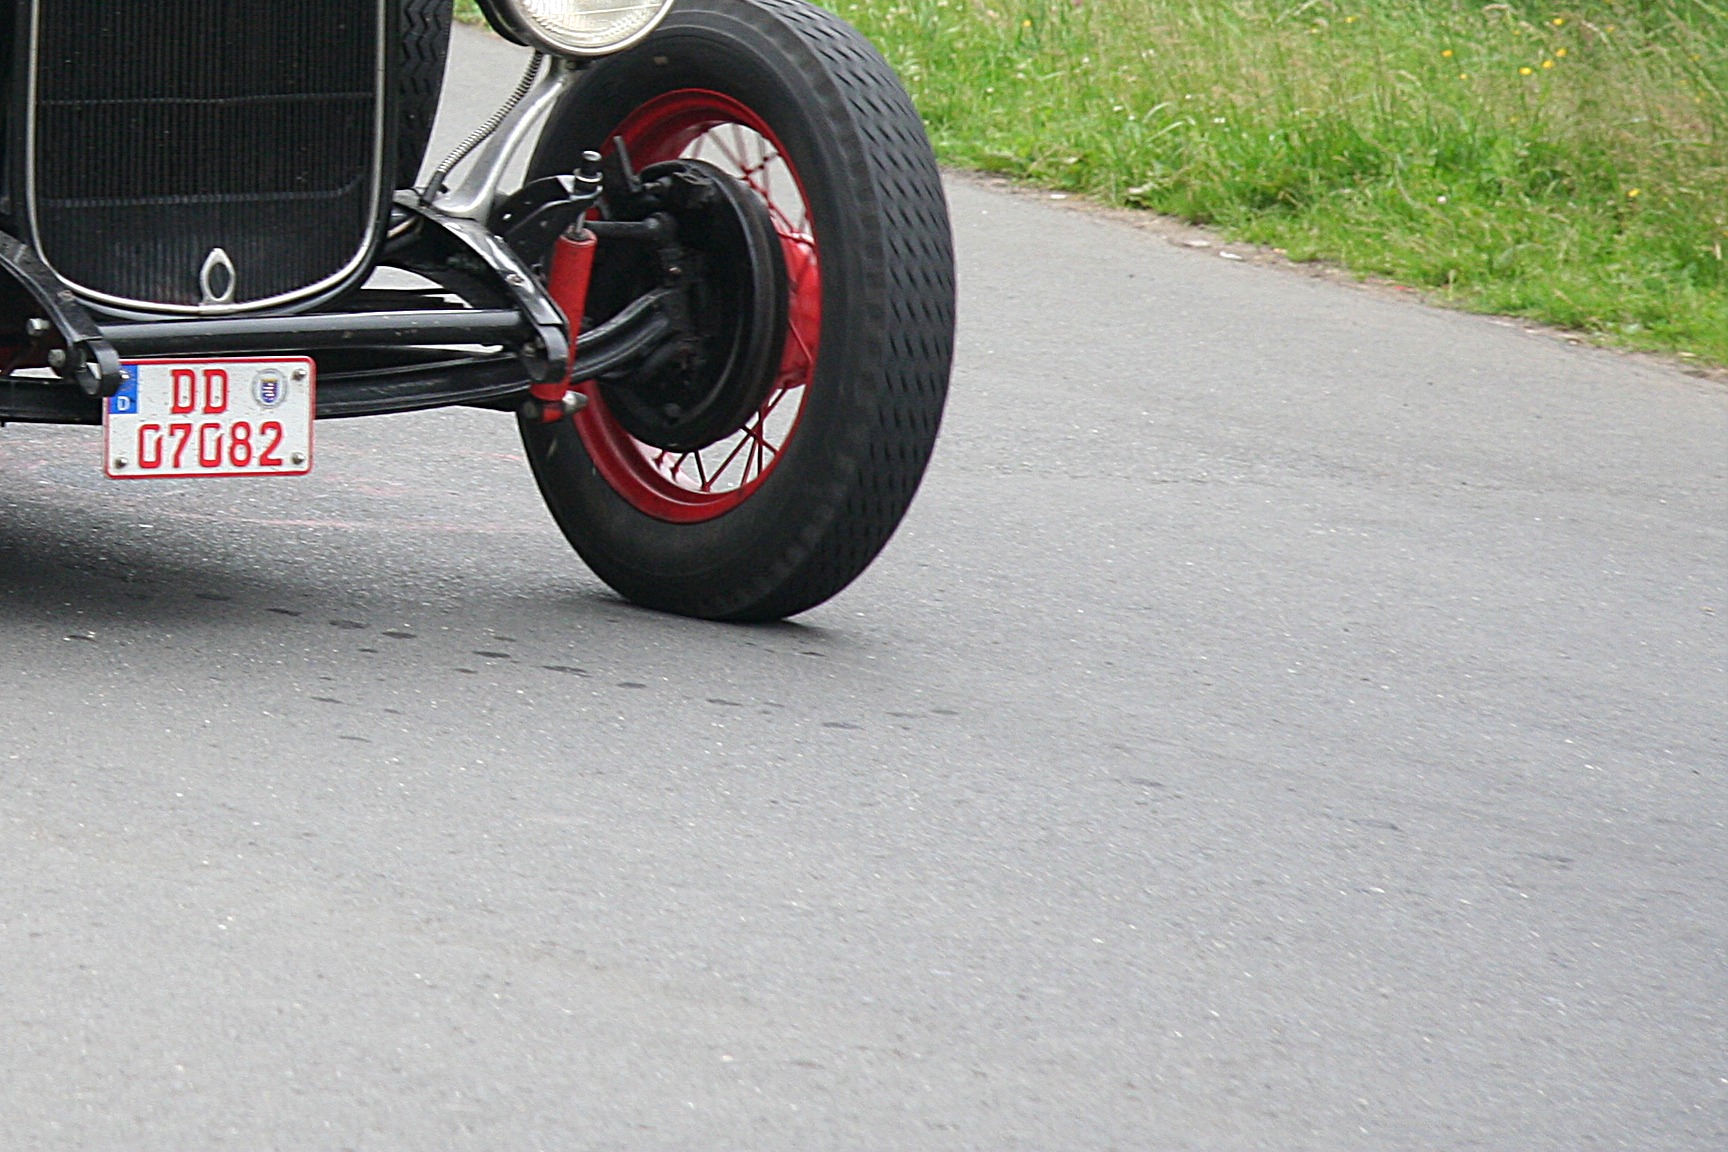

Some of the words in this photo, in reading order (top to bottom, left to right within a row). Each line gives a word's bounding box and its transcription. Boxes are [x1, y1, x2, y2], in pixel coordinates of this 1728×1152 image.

[117, 396, 131, 412] D
[171, 368, 229, 415] DD
[138, 421, 283, 469] 07082
